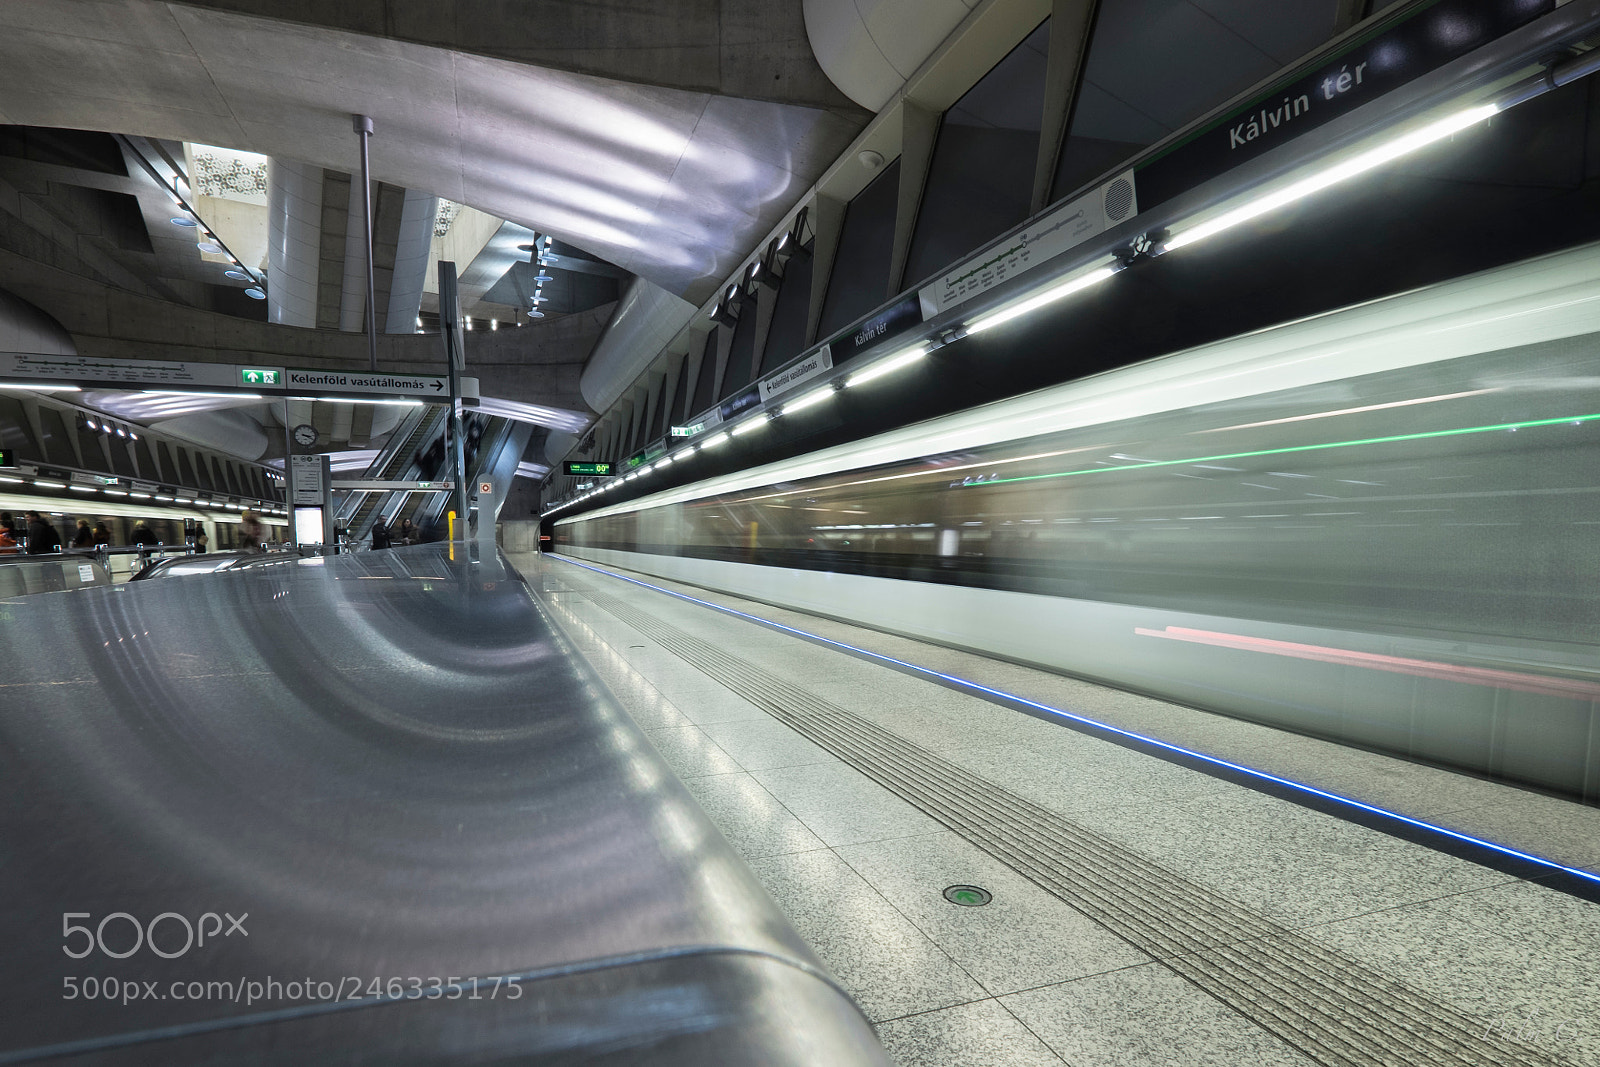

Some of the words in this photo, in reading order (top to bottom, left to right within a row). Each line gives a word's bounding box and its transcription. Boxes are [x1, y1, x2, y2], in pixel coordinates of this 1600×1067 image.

[1229, 94, 1309, 150] Kálvin
[1321, 61, 1367, 100] tér
[854, 327, 876, 347] Kálvin
[876, 321, 888, 335] tér
[291, 372, 348, 387] Kelenföld
[350, 375, 425, 390] vasútállomás
